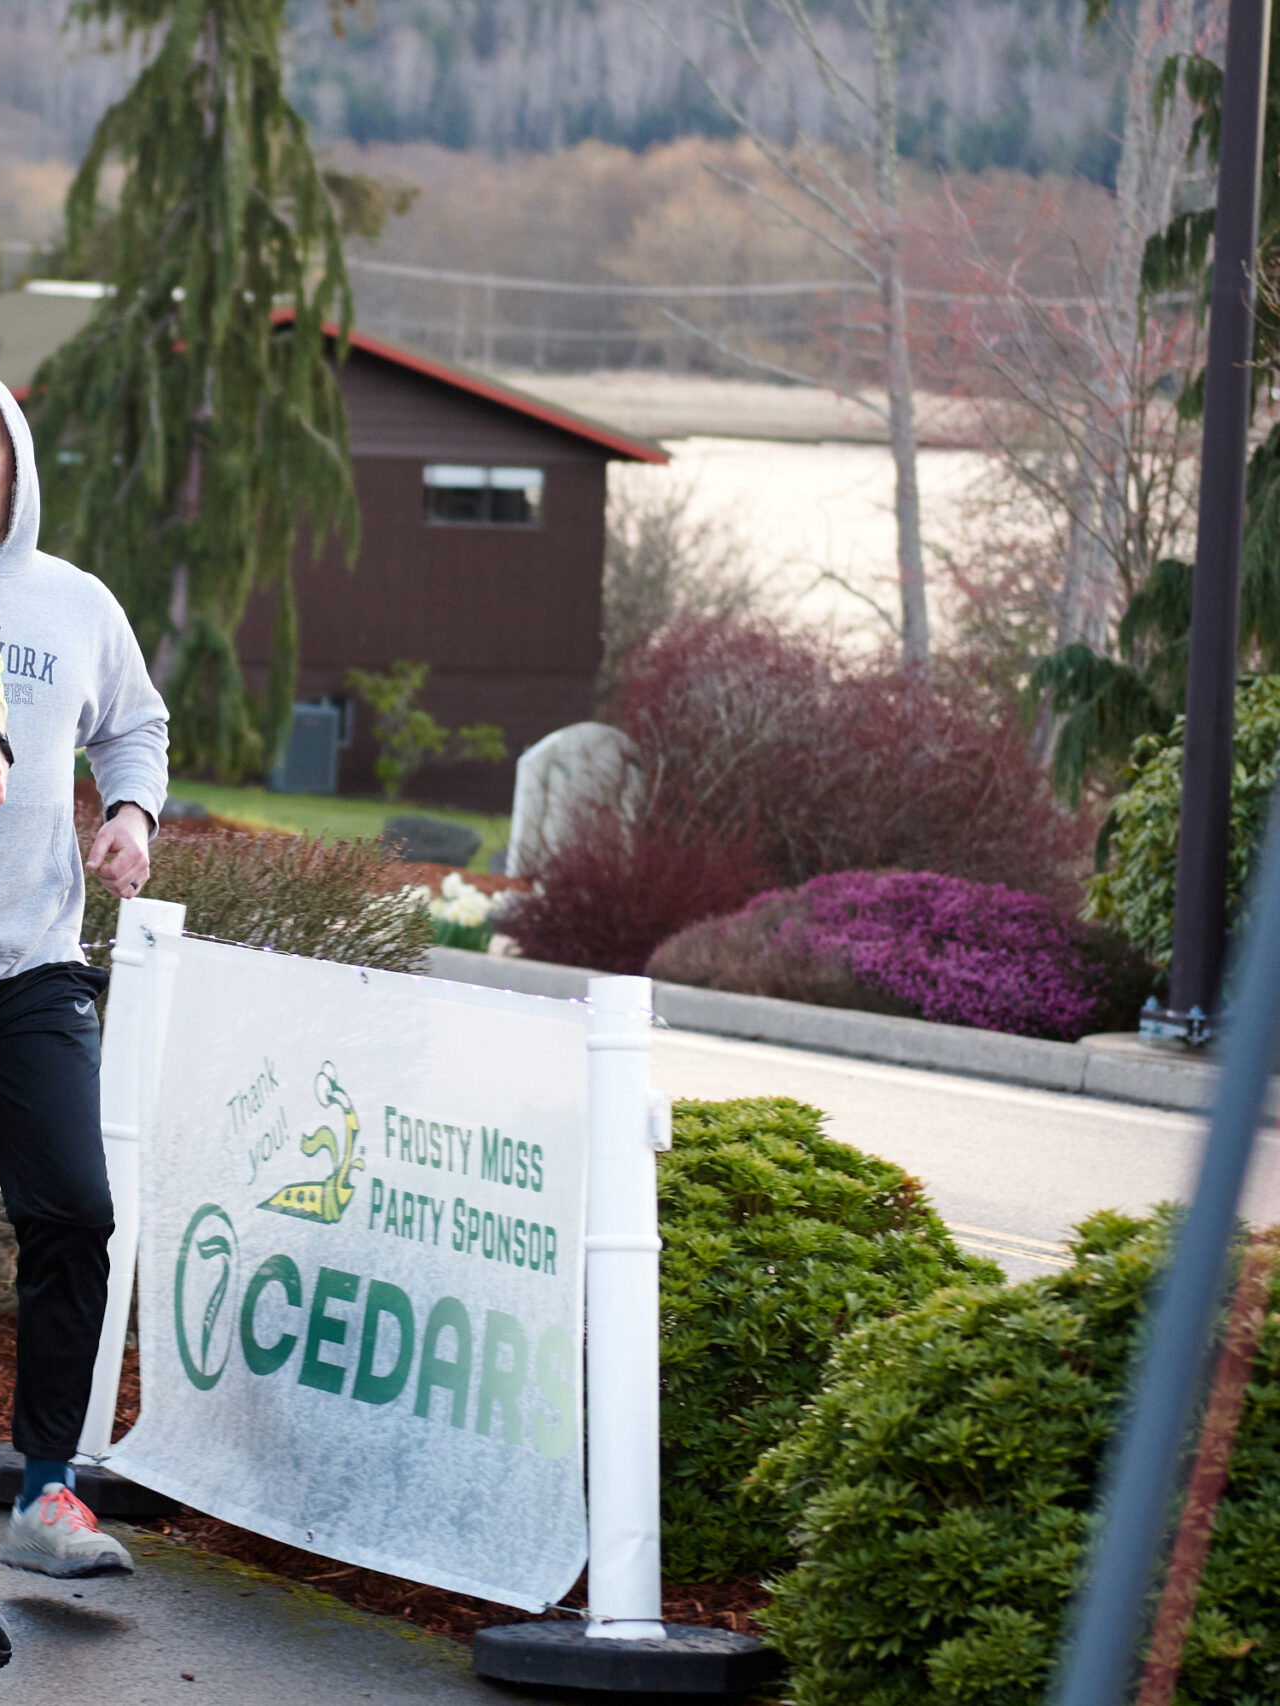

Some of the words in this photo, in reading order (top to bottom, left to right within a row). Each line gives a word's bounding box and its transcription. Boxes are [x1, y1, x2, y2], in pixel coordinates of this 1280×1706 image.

[226, 1055, 280, 1135] Thank
[247, 1104, 291, 1186] you!
[384, 1105, 473, 1176] FROSTY
[368, 1177, 446, 1246] PARTY
[451, 1196, 557, 1276] SPONSOR
[239, 1253, 576, 1460] CEDARS
